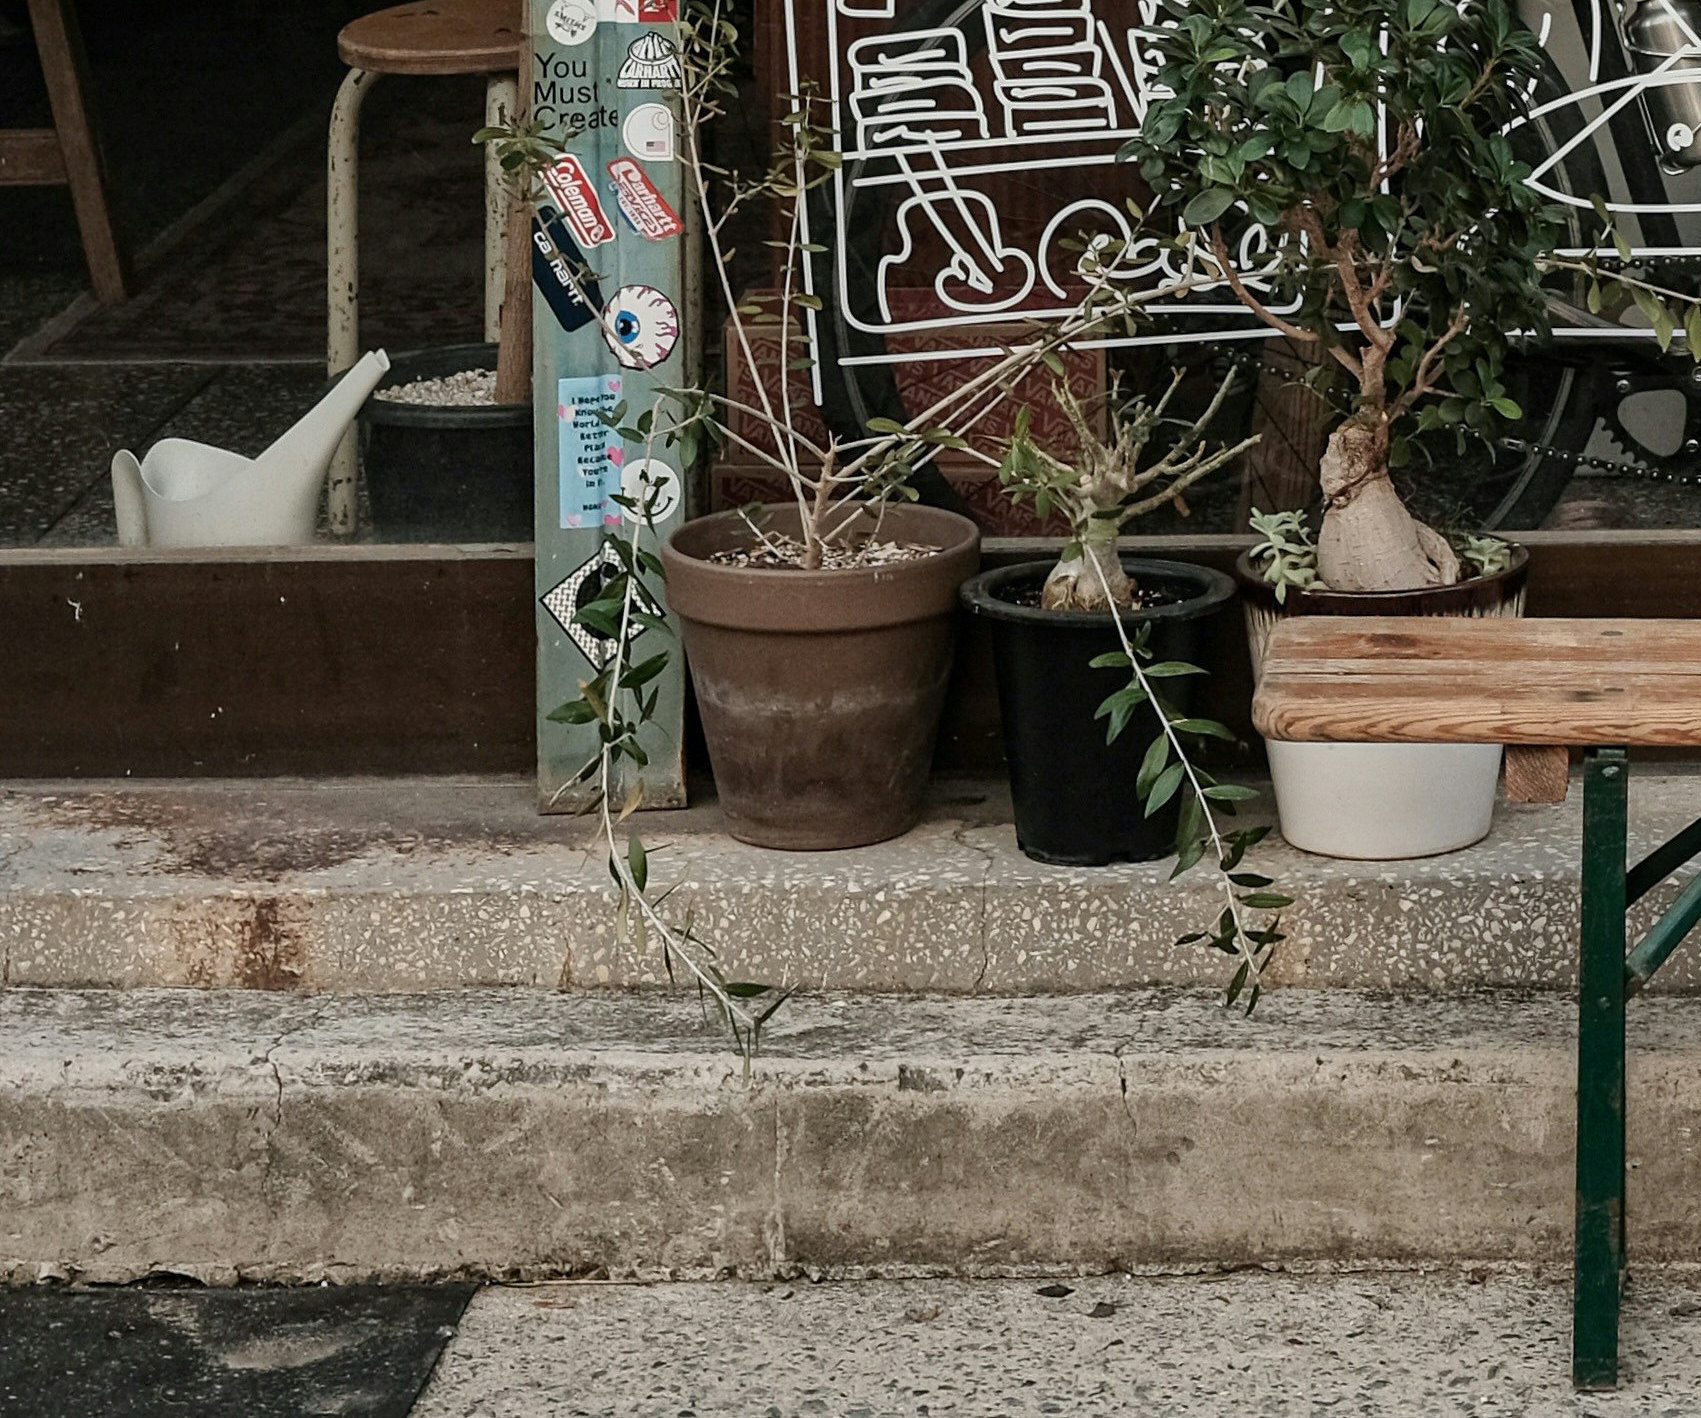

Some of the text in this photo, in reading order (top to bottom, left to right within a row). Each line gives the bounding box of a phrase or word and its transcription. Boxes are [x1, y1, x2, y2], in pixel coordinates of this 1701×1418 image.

[534, 52, 587, 79] You
[534, 80, 599, 105] Must
[533, 105, 619, 131] Create
[553, 161, 598, 229] Coleman
[533, 231, 584, 305] cahartt
[575, 408, 595, 417] Kno
